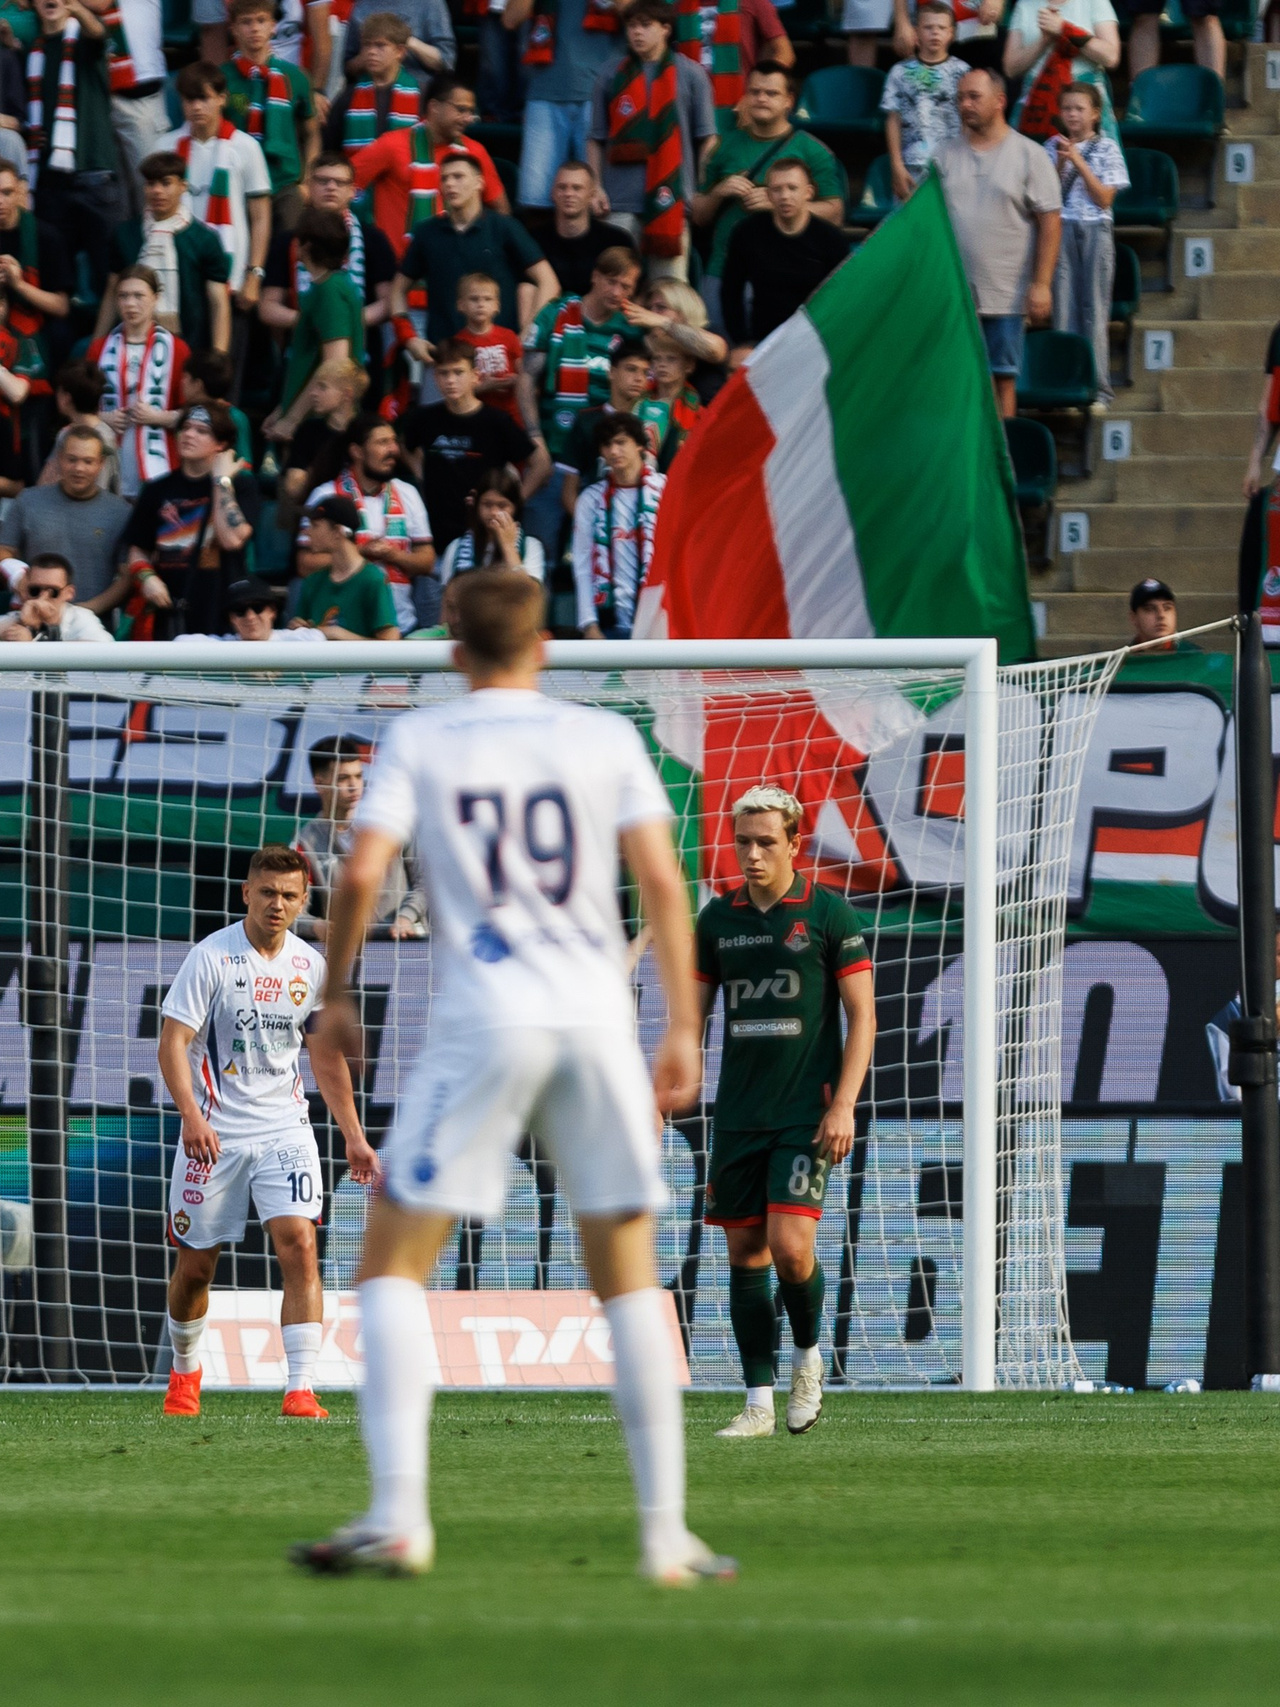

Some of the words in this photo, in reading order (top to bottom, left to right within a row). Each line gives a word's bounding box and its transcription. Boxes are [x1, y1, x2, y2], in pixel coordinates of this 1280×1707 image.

[456, 784, 576, 905] 79
[719, 934, 773, 949] BetBoom
[254, 976, 283, 989] FON
[253, 990, 283, 1003] BET
[260, 1020, 293, 1031] ЗНАК
[739, 1021, 798, 1033] СОВКОМБАНК
[186, 1160, 213, 1175] FON
[184, 1172, 211, 1185] BET
[788, 1154, 827, 1200] 83
[287, 1171, 314, 1203] 10
